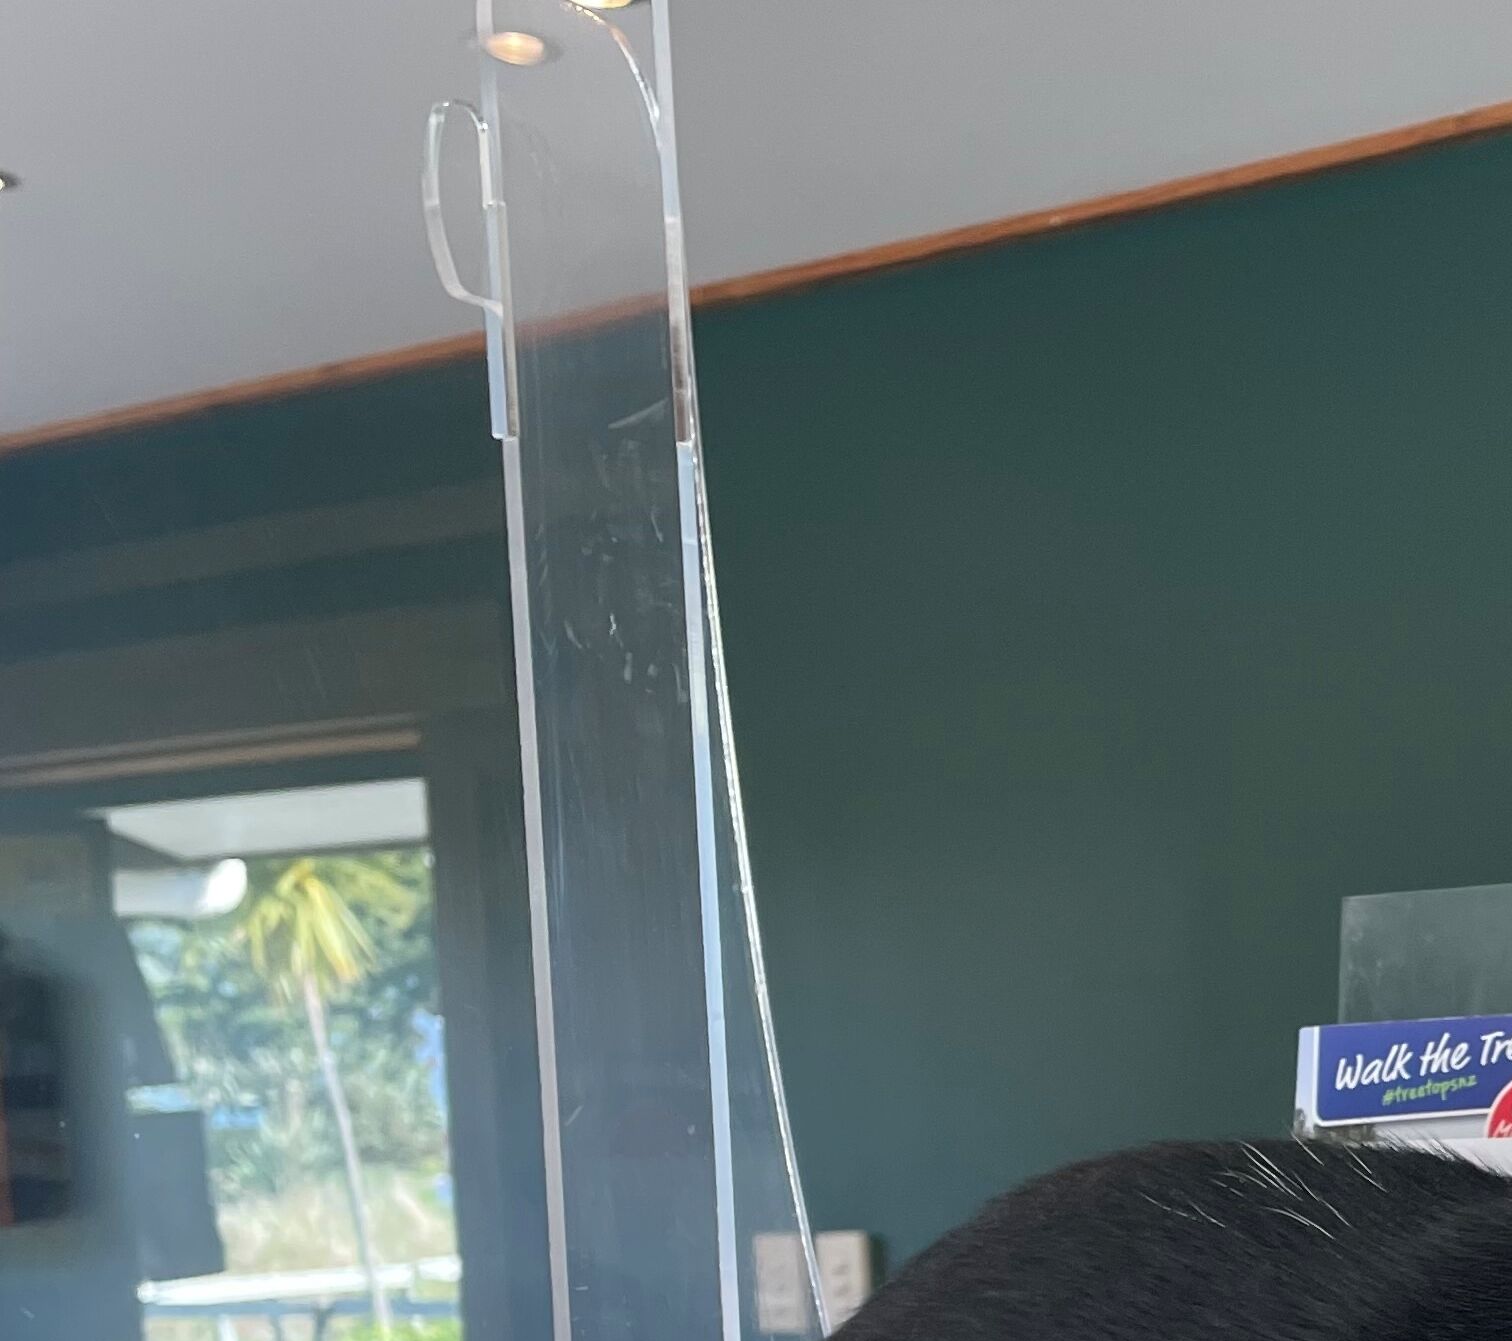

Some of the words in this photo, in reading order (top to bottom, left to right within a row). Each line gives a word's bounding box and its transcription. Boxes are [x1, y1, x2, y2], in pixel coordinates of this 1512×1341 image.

[1335, 1044, 1414, 1091] Walk
[1419, 1032, 1471, 1077] the
[1381, 1074, 1478, 1107] #treetopsnz
